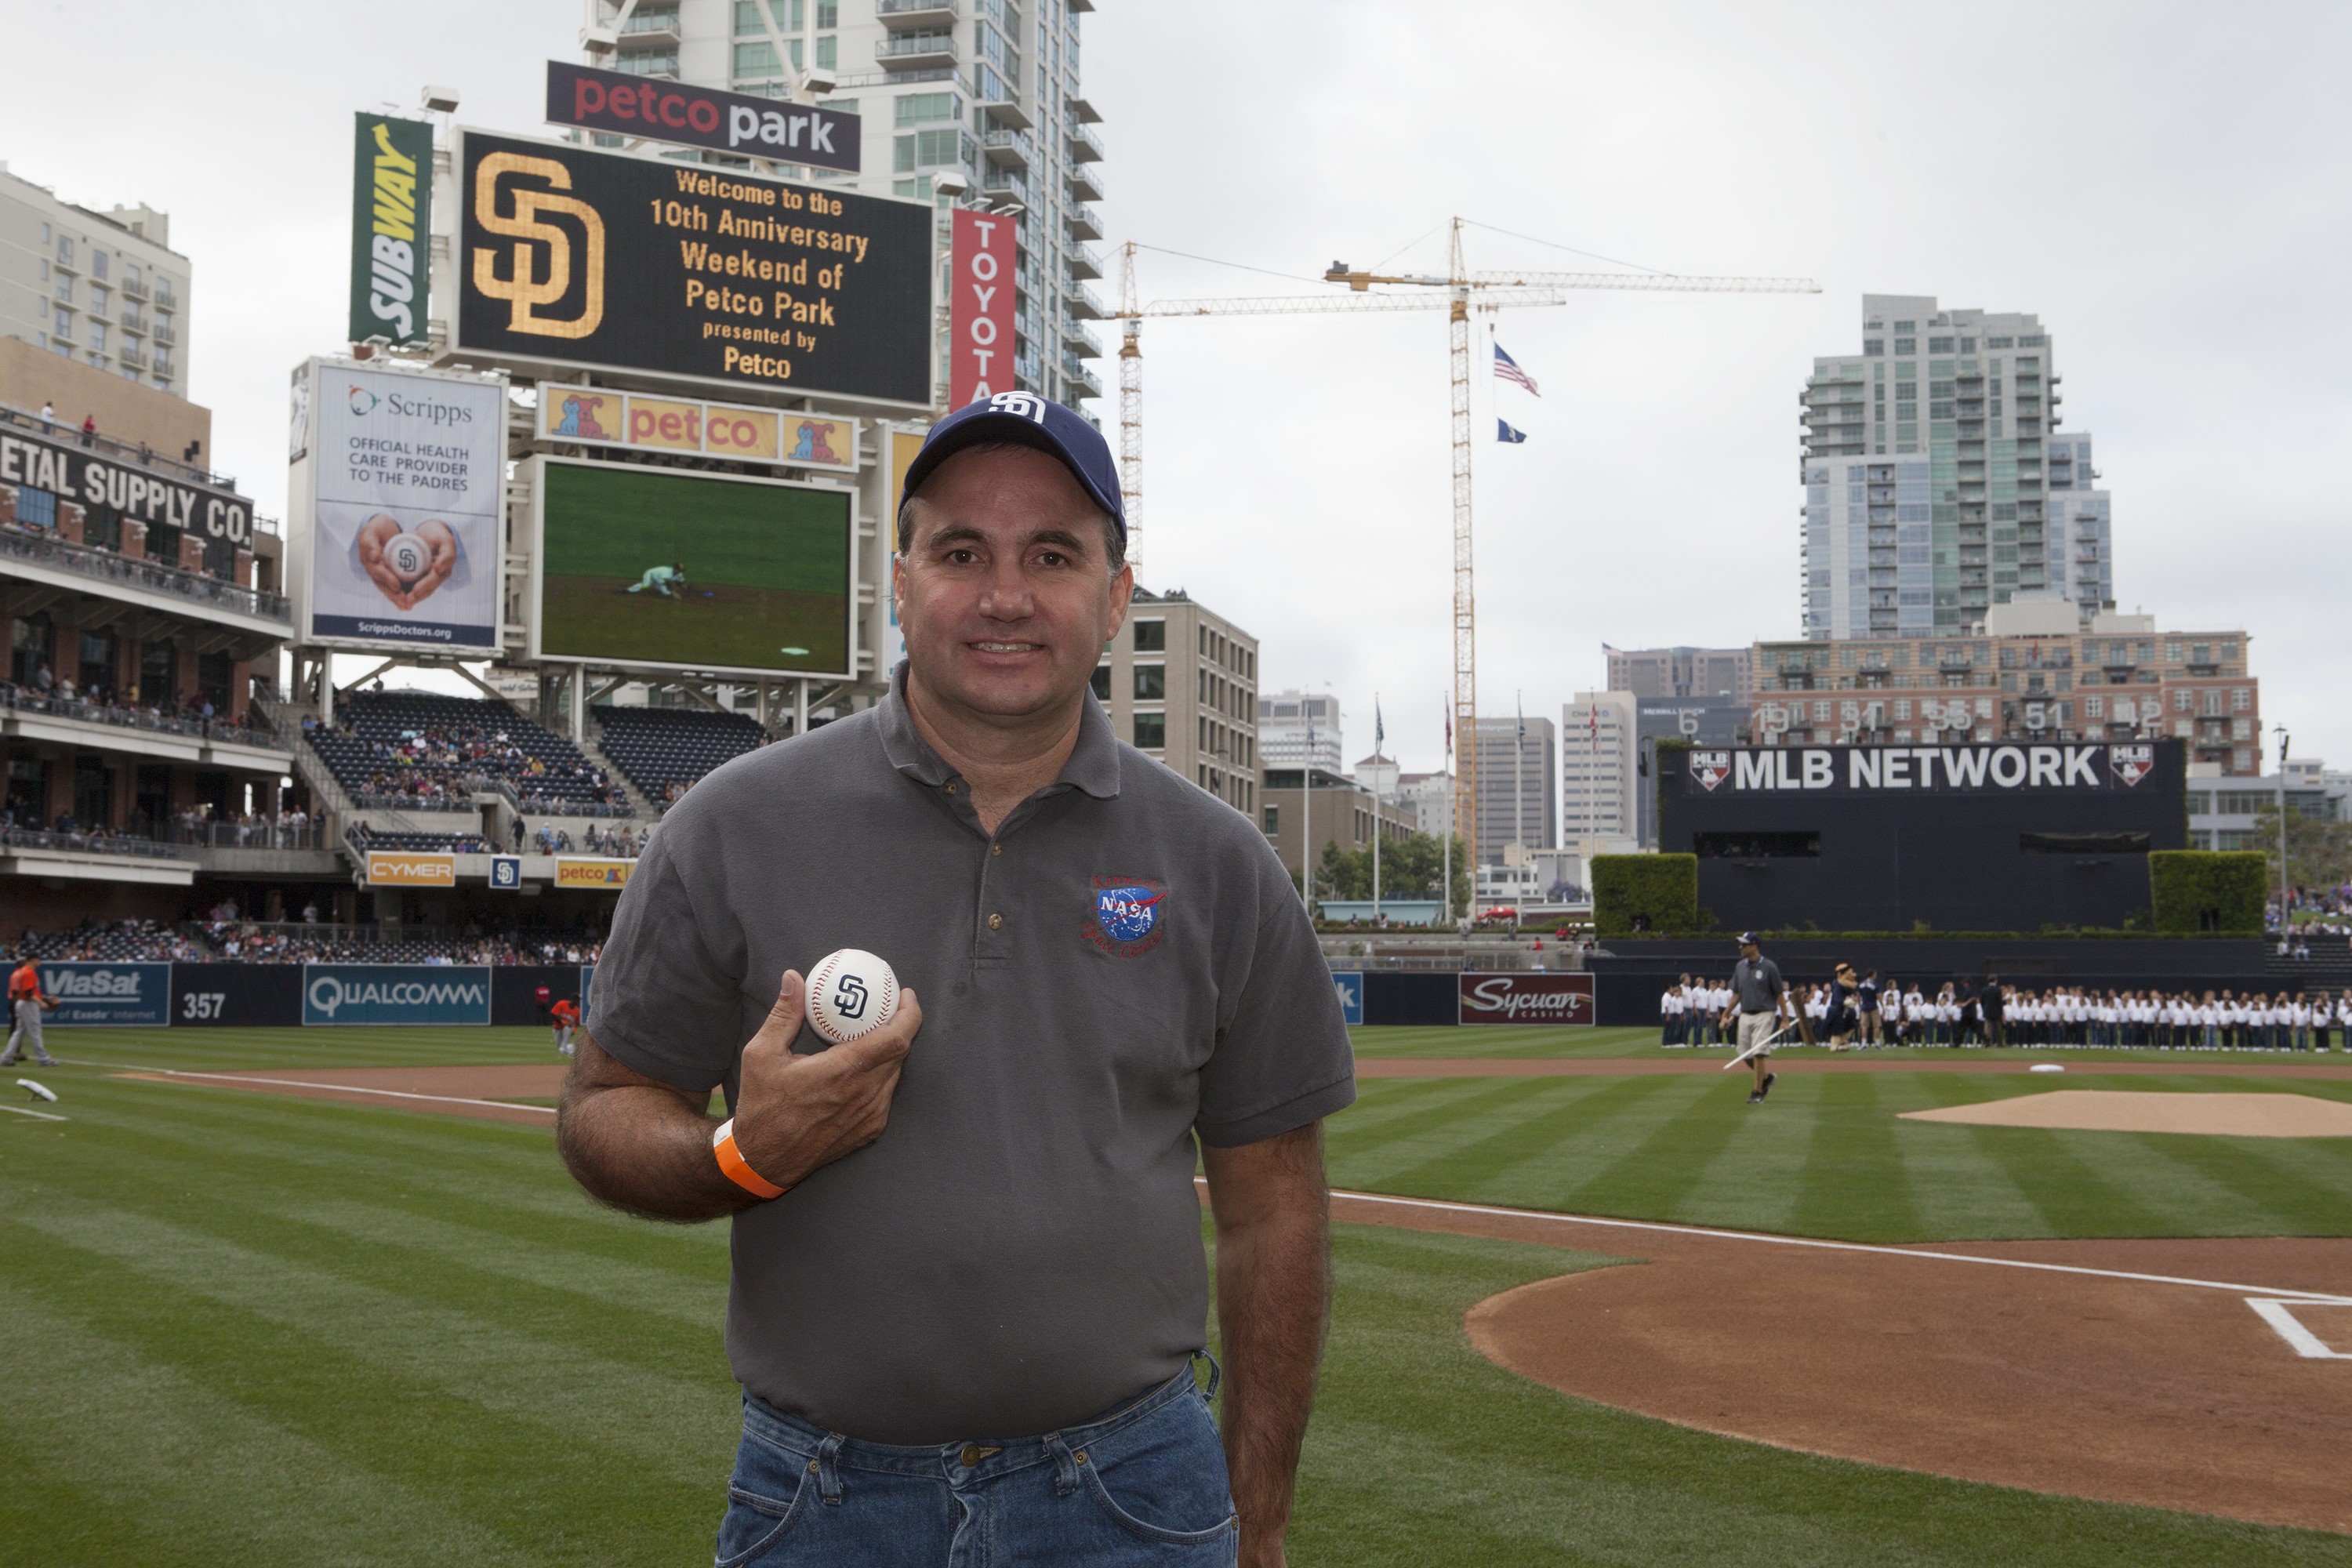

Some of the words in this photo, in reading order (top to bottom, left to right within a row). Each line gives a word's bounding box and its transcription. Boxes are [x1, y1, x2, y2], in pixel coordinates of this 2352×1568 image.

[575, 78, 720, 133] petco
[729, 105, 835, 154] park
[675, 169, 776, 206] Welcome
[782, 188, 803, 210] to
[809, 193, 843, 216] the
[369, 122, 417, 339] SUBWAY
[651, 199, 708, 231] 10th
[717, 209, 869, 263] Anniversary
[681, 240, 808, 286] Weekend
[818, 263, 844, 290] of
[686, 278, 764, 316] Petco
[775, 291, 836, 326] Park
[971, 220, 998, 405] TOYOTA
[702, 321, 791, 346] presented
[797, 331, 817, 353] by
[724, 345, 791, 379] Petco
[388, 393, 473, 426] Scripps
[630, 407, 759, 448] petco
[349, 437, 411, 455] OFFICIAL
[416, 443, 469, 460] HEALTH
[349, 452, 388, 468] CARE
[396, 457, 468, 476] PROVIDER
[349, 468, 370, 482] TO
[379, 472, 405, 485] THE
[412, 474, 468, 492] PADRES
[85, 463, 196, 529] SUPPLY
[207, 499, 251, 546] CO.
[358, 621, 452, 641] ScrippsDoctors.org
[2027, 702, 2063, 730] 51
[1692, 753, 1727, 764] MLB
[1735, 750, 1835, 789] MLB
[1849, 746, 2100, 789] NETWORK
[2113, 747, 2150, 758] MLB
[372, 862, 452, 877] CYMER
[560, 866, 604, 881] petco
[1101, 896, 1153, 921] NASA
[43, 969, 141, 996] ViaSat
[309, 976, 484, 1018] QUALCOMM
[1474, 978, 1581, 1019] Sycuan
[183, 993, 226, 1019] 357
